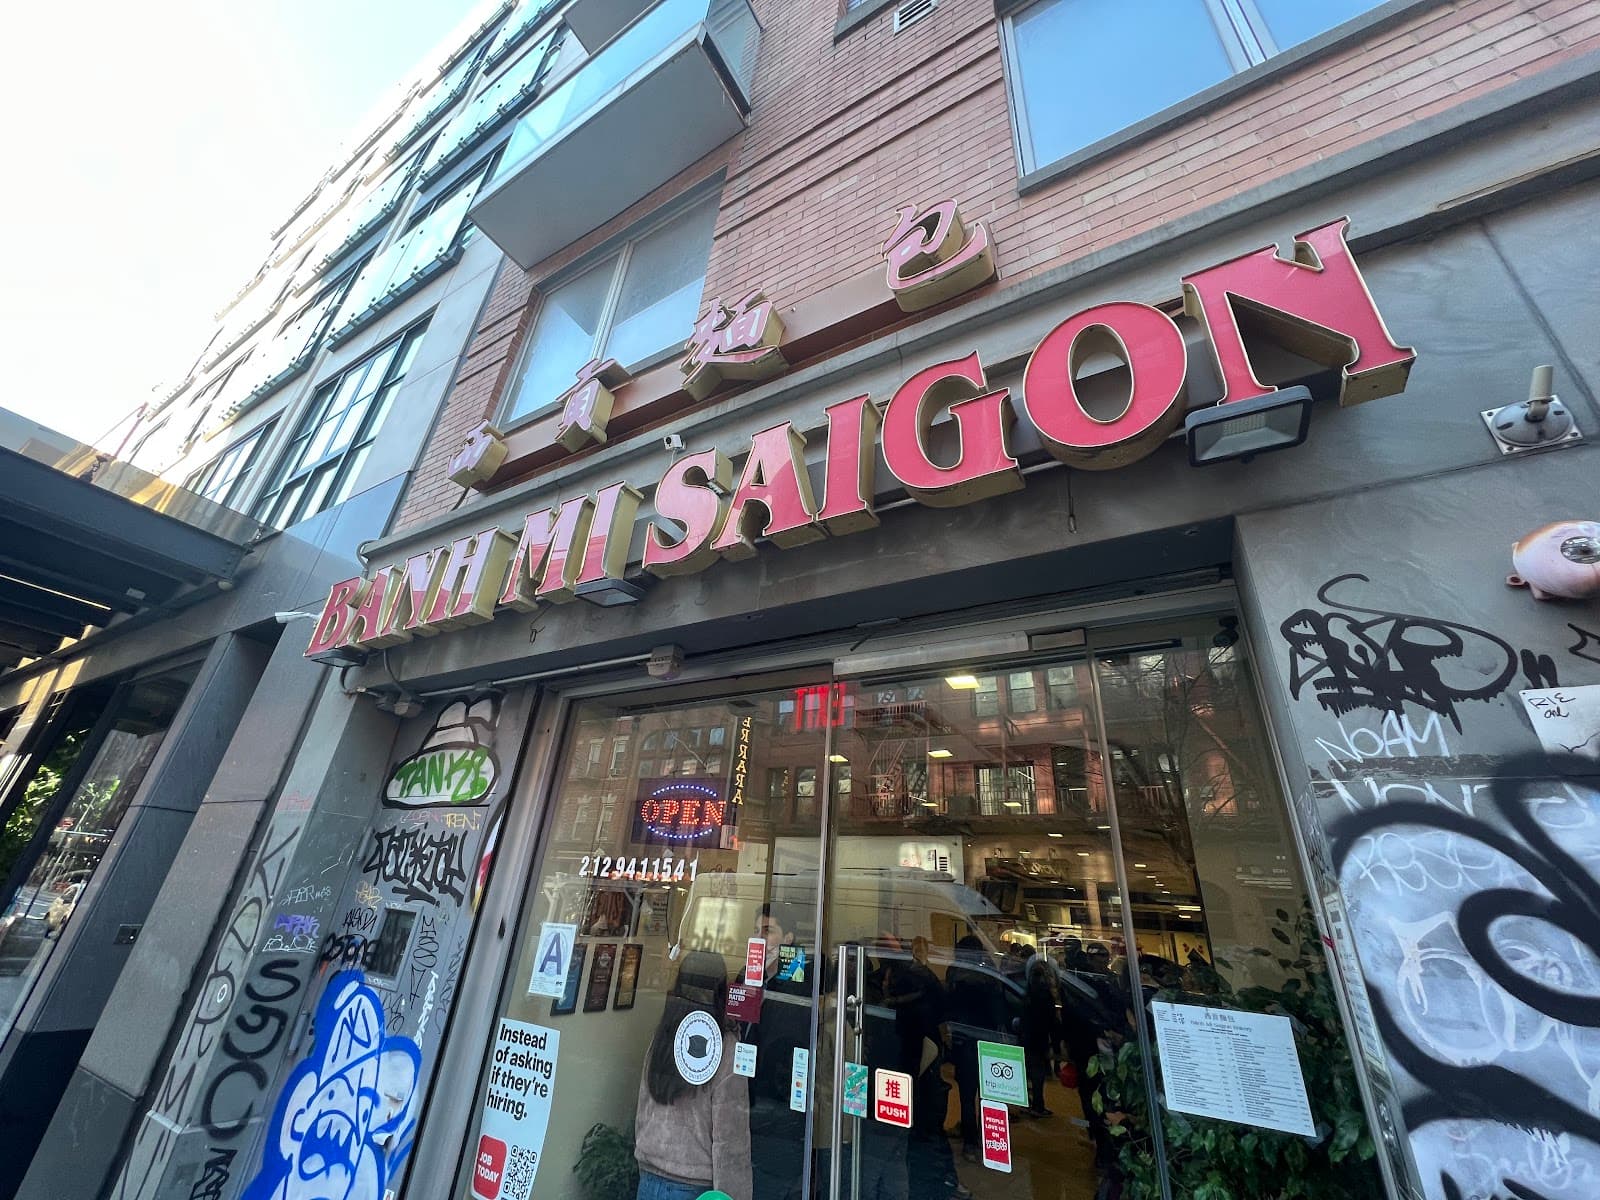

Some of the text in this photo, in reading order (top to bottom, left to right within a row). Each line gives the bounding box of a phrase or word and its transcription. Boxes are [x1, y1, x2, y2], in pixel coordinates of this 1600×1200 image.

[304, 215, 1416, 657] BANH MI SAIGON
[1315, 710, 1450, 772] NOAM
[641, 799, 726, 826] OPEN
[539, 932, 563, 976] A
[500, 1023, 547, 1051] Instead
[495, 1046, 553, 1079] of asking
[491, 1066, 549, 1098] if they're
[885, 1079, 901, 1098] 推
[487, 1088, 528, 1121] hiring.
[880, 1105, 906, 1120] PUSH
[985, 1116, 1005, 1125] PEOPLE
[479, 1151, 493, 1167] JOB
[476, 1164, 499, 1183] TODAY
